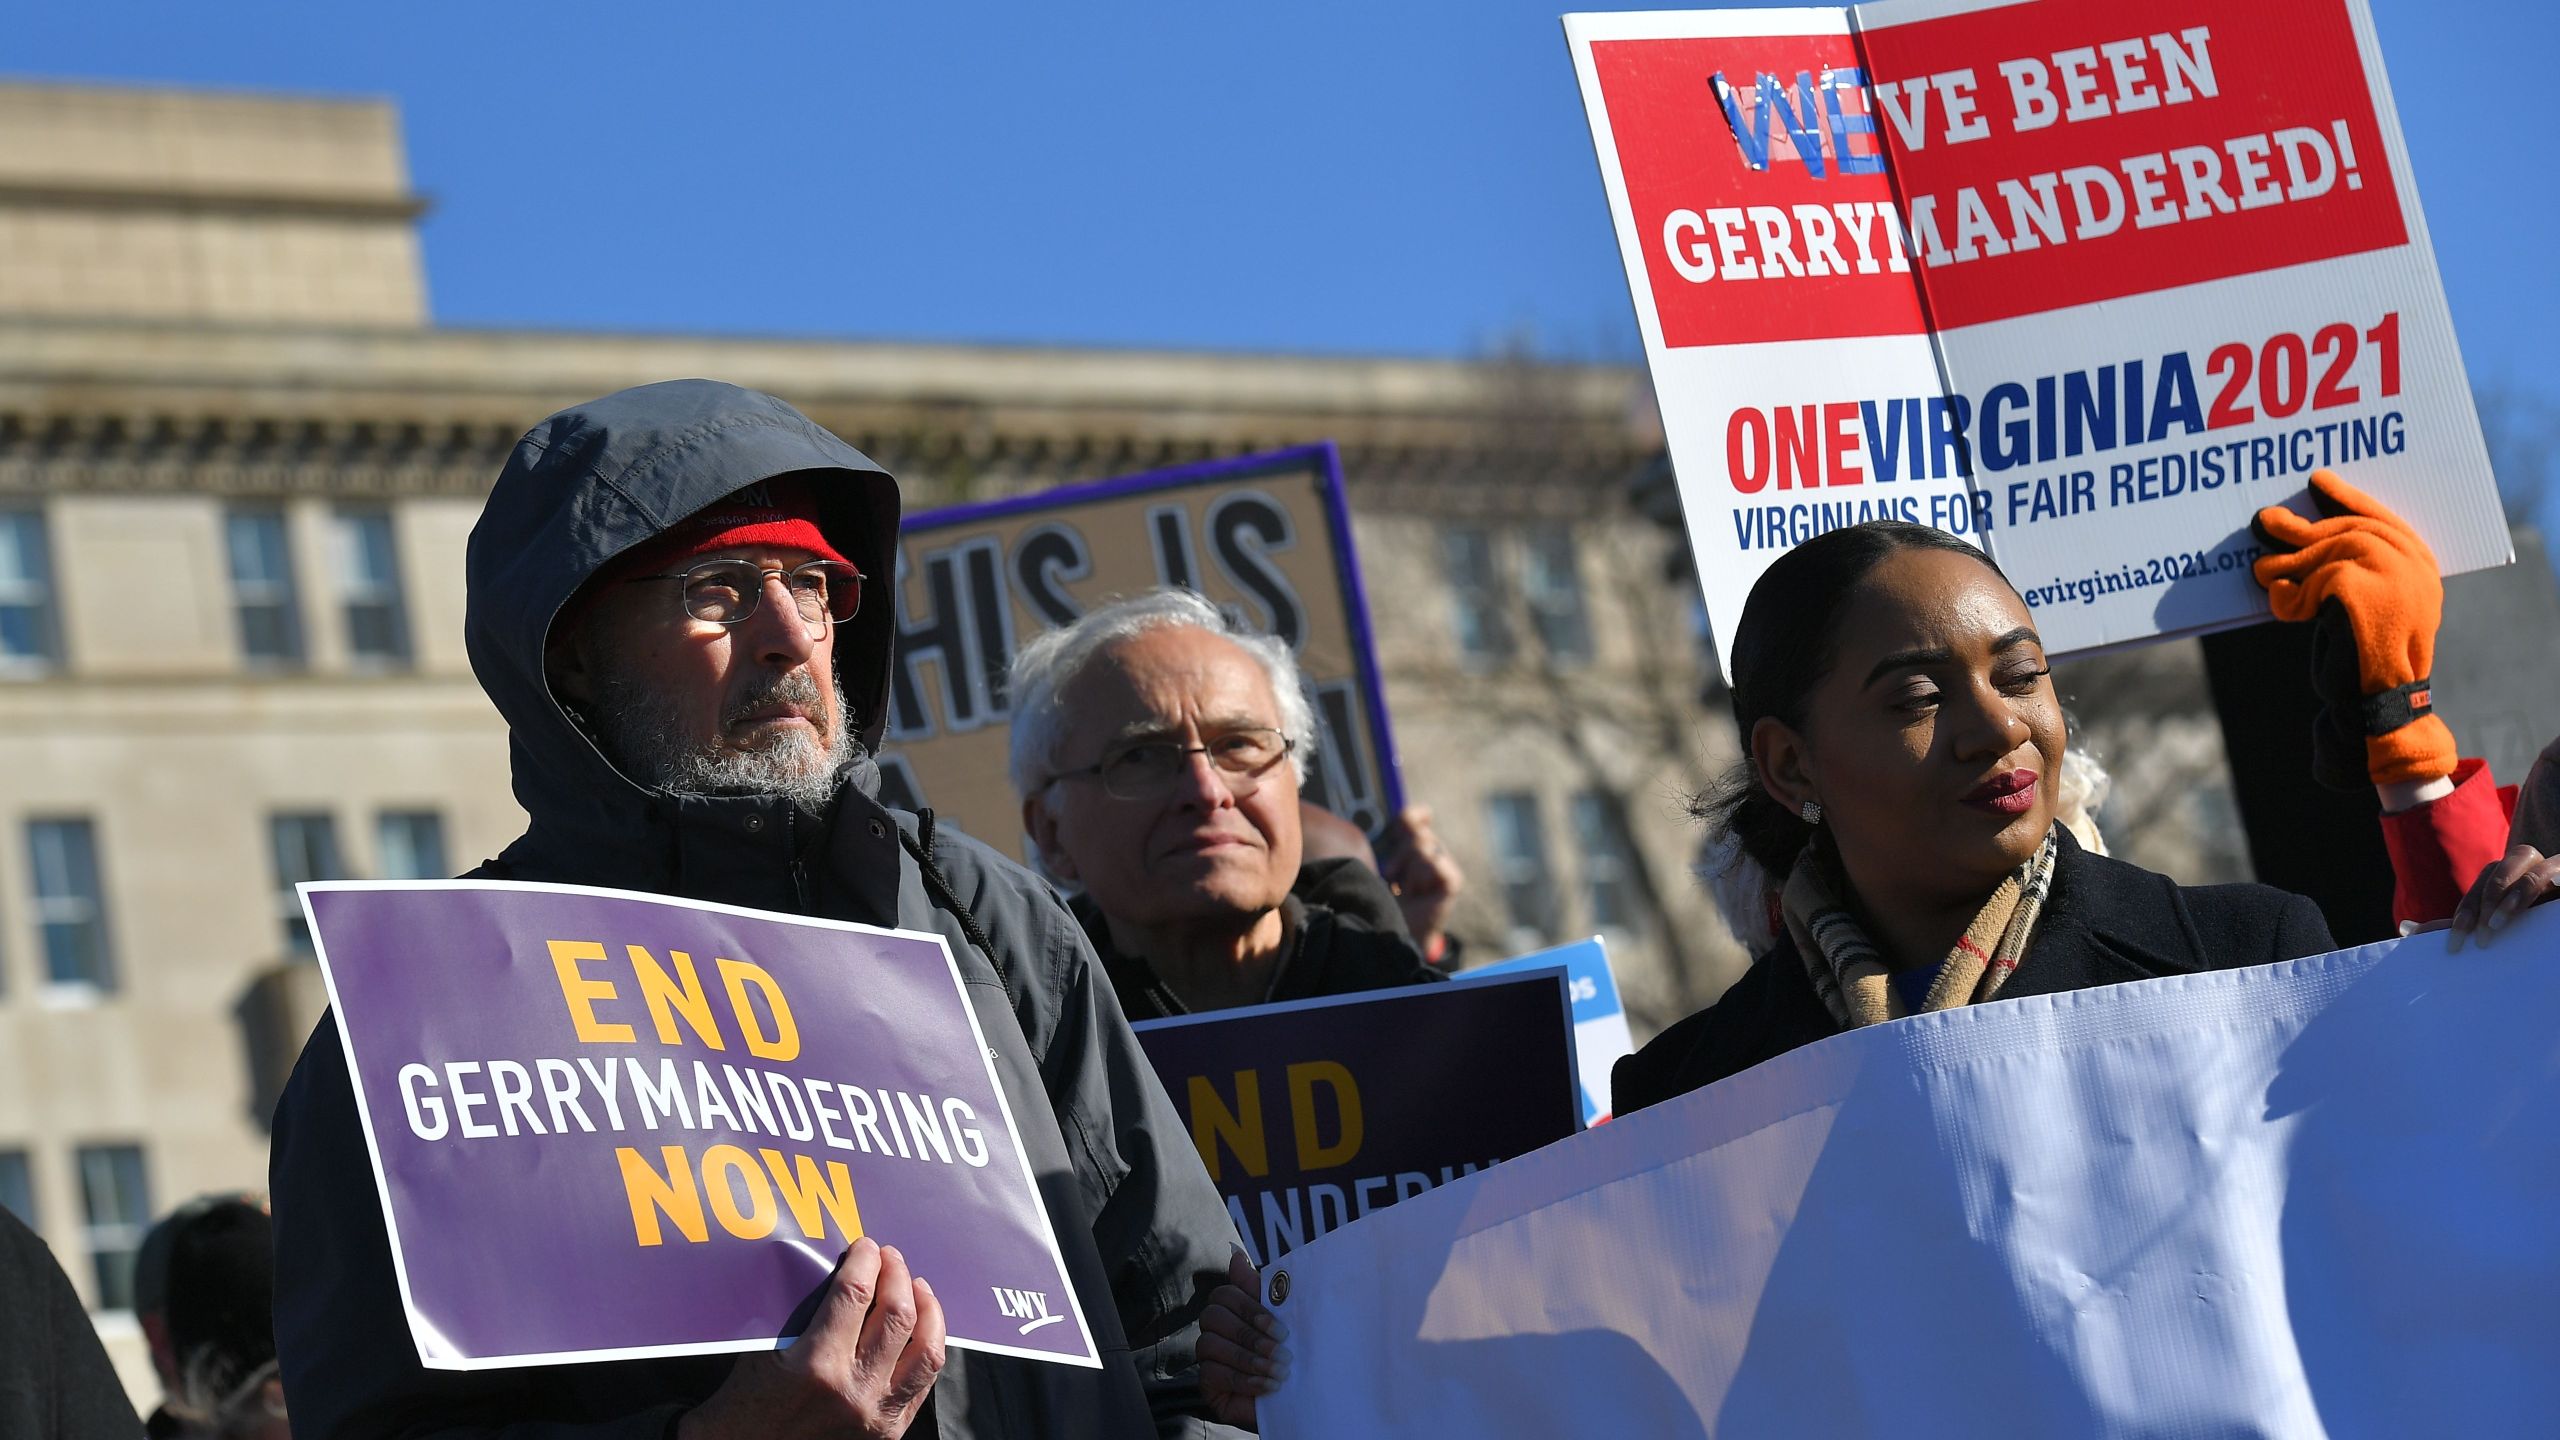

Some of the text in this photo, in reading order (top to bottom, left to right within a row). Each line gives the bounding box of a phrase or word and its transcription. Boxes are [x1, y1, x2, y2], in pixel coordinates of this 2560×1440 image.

[1998, 26, 2219, 132] BEEN
[1663, 120, 2362, 283] GERRYMANDERED!
[1726, 312, 2402, 494] ONEVIRGINIA2021
[1930, 490, 1994, 534] FOR
[2008, 470, 2096, 527] FAIR
[2110, 411, 2405, 507] REDISTRICTING
[888, 522, 1093, 742] HIS
[2025, 546, 2260, 608] evirginia2021.or
[548, 940, 801, 1062] END
[398, 1059, 990, 1169] GERRYMANDERING
[1188, 1061, 1364, 1181] ND
[616, 1145, 865, 1246] NOW
[991, 1286, 1065, 1335] LWV
